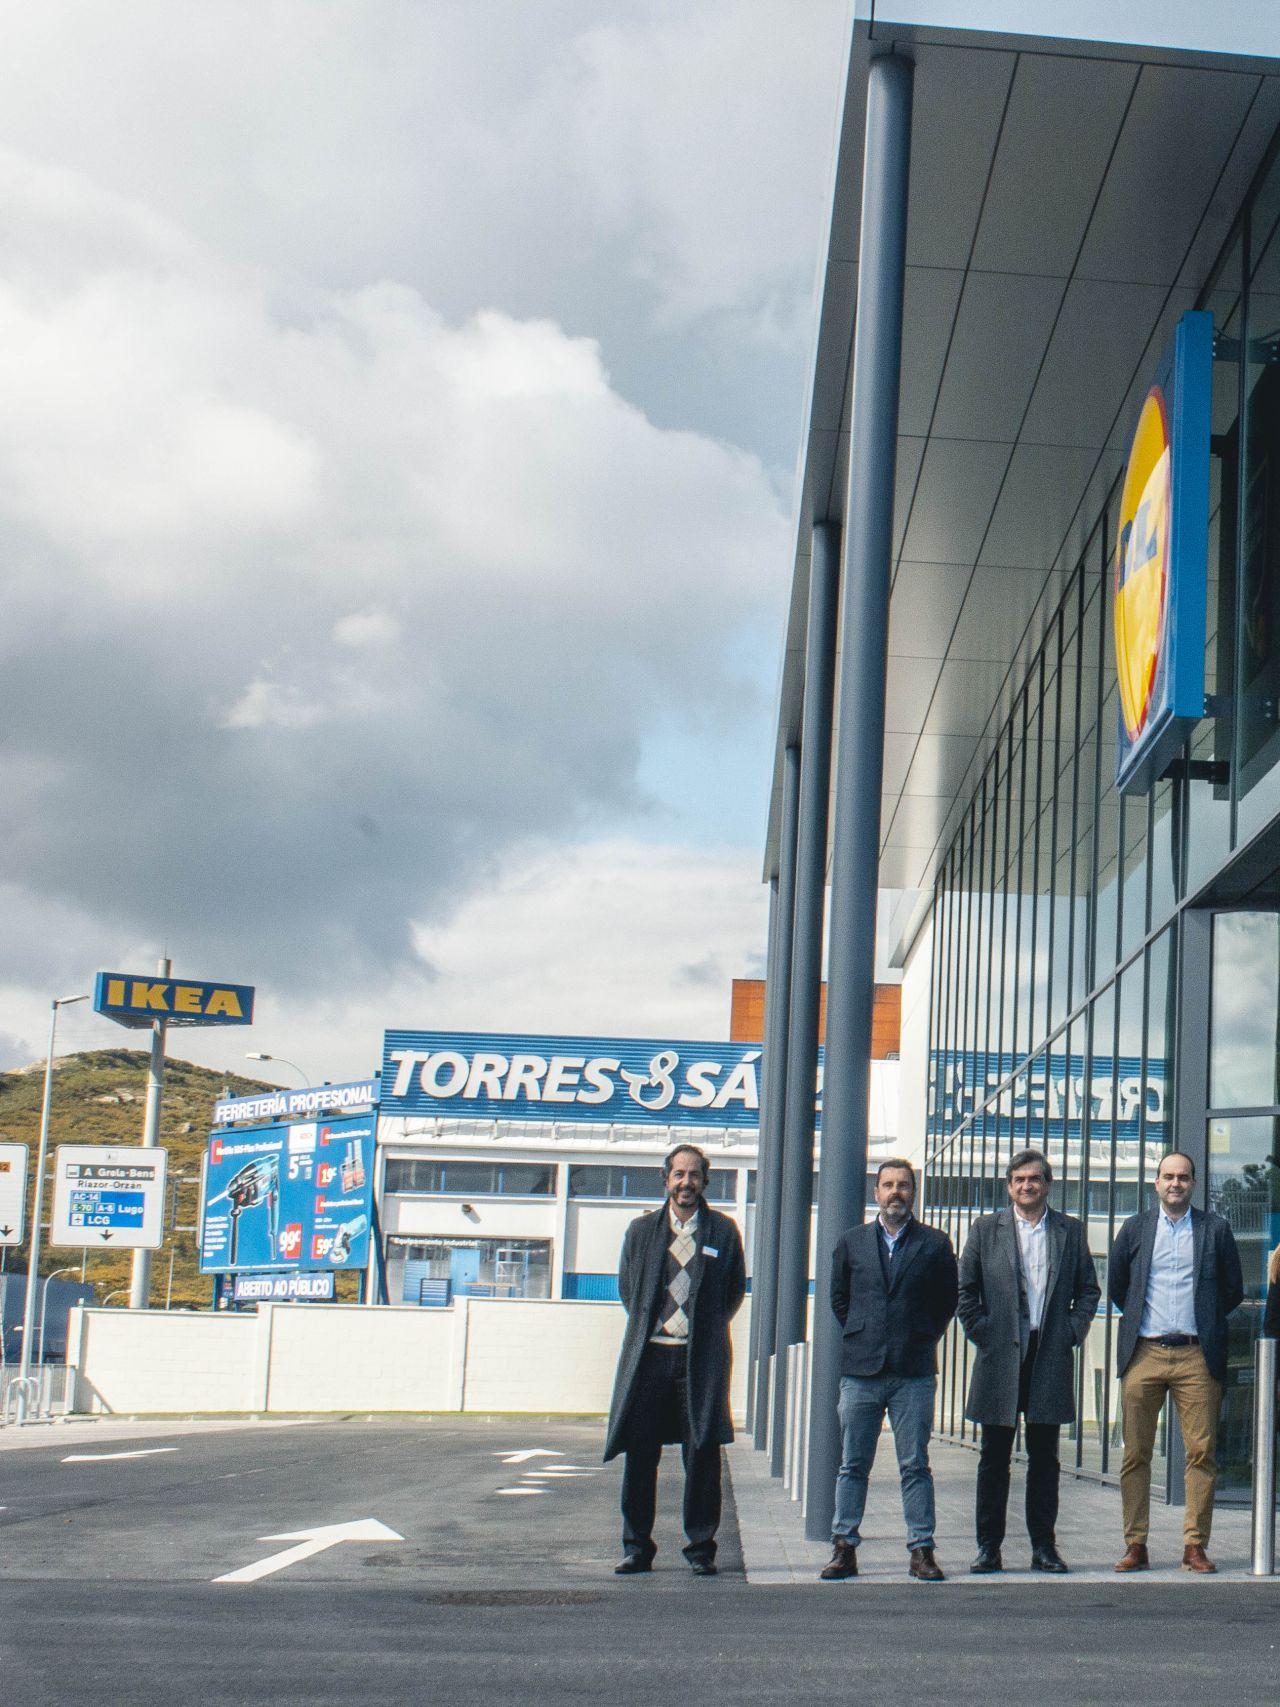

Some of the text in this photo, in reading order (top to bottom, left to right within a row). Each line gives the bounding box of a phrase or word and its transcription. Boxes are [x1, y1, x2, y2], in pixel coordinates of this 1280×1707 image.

[107, 979, 243, 1017] IKEA
[390, 1050, 763, 1111] TORRES & SÁ
[215, 1085, 376, 1122] FERRETERÍA PROFESIONAL
[84, 1168, 155, 1178] A Grela-Bens
[288, 1155, 299, 1179] 5
[73, 1193, 99, 1201] AC-14
[118, 1205, 144, 1215] Lugo
[88, 1216, 110, 1225] LCG
[237, 1280, 272, 1296] ABERTO
[273, 1280, 286, 1295] AO
[288, 1277, 330, 1296] PÚBLICO
